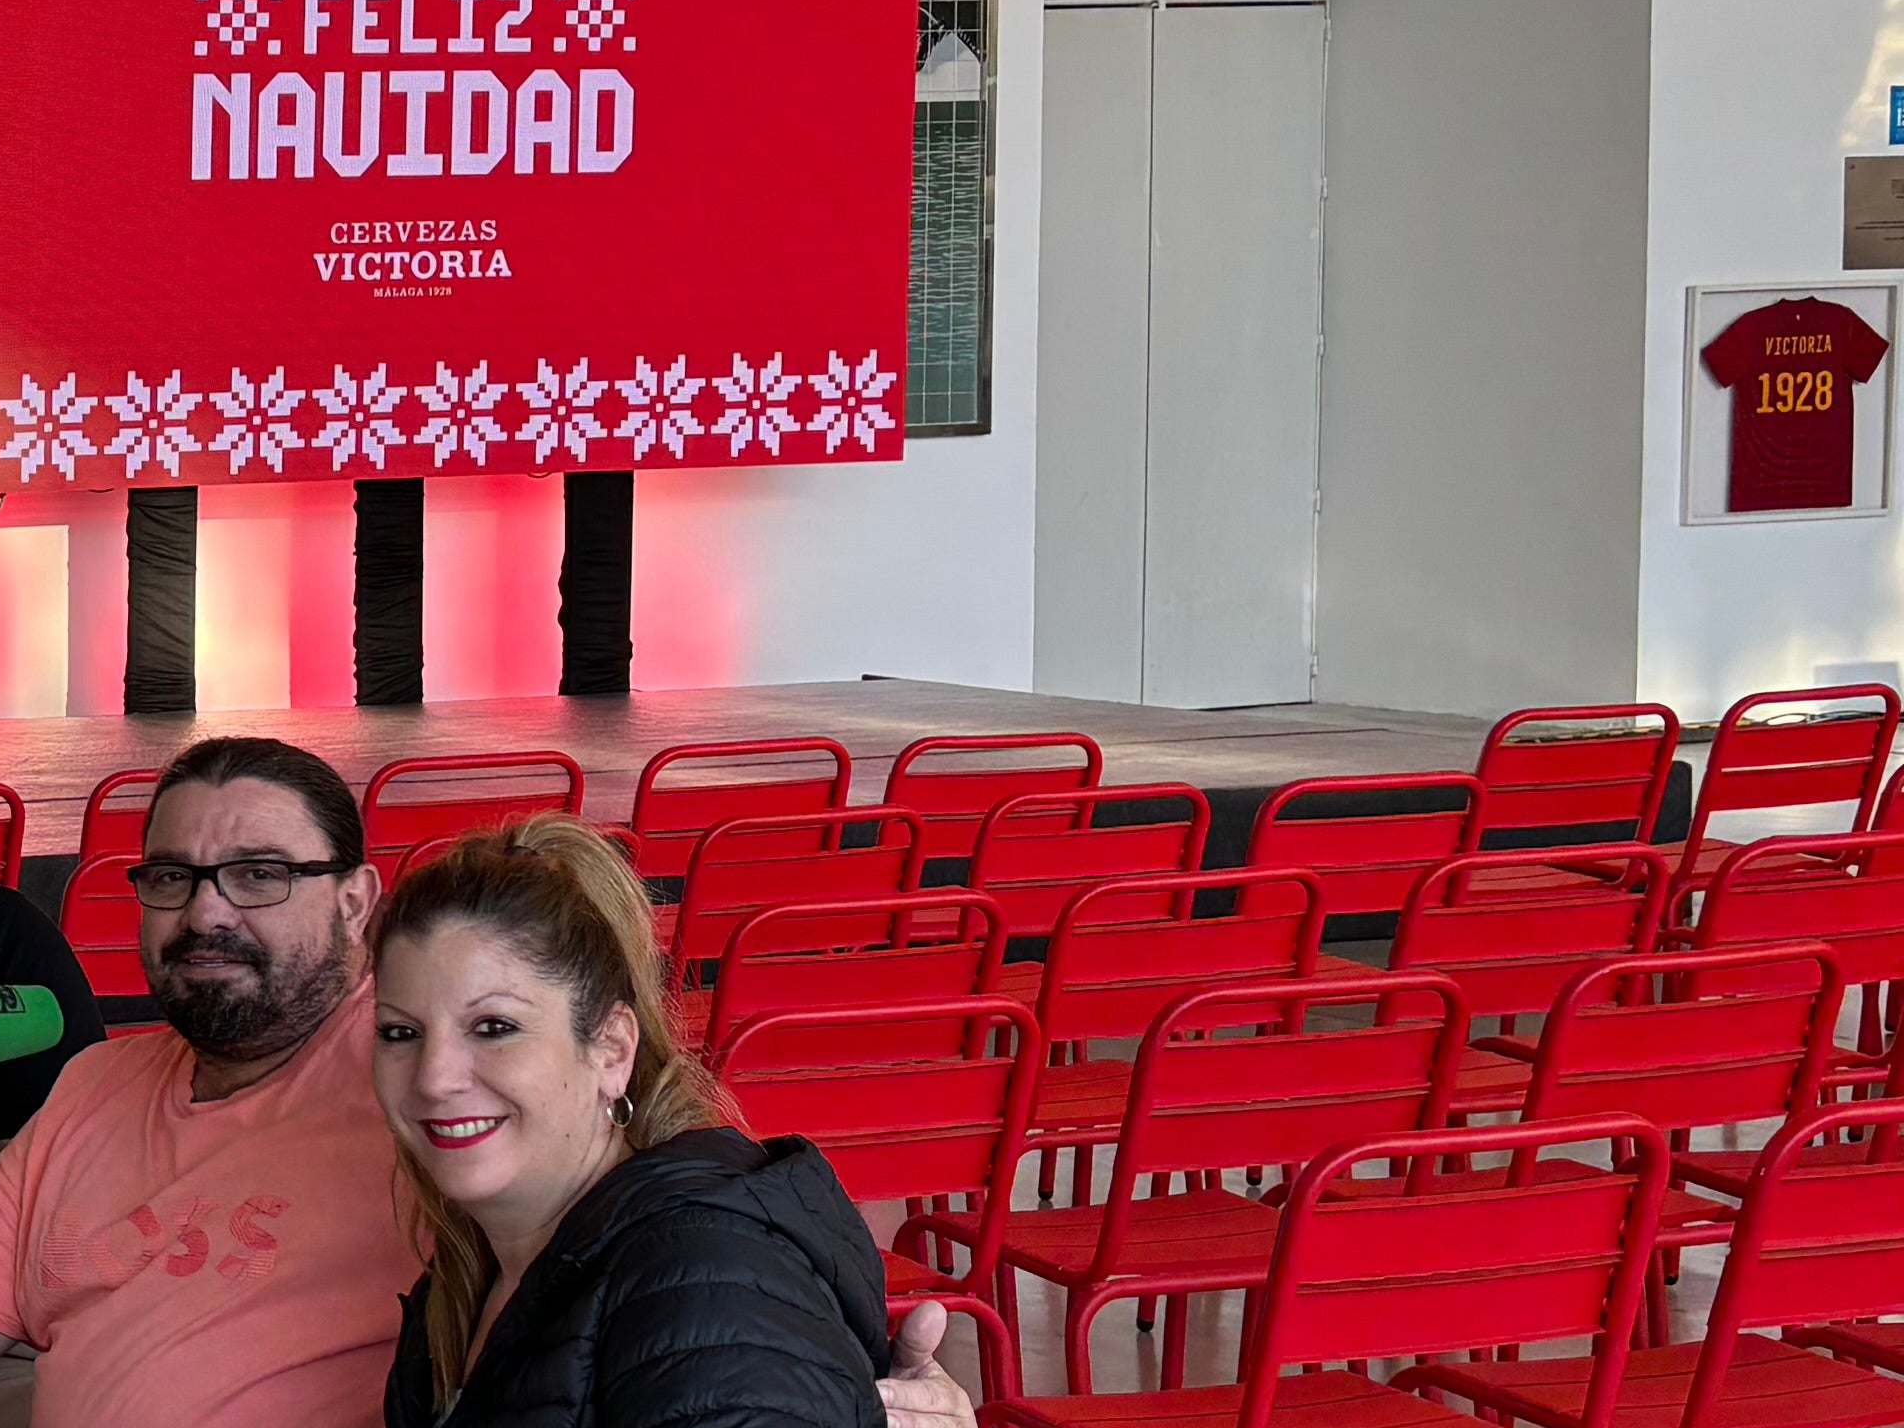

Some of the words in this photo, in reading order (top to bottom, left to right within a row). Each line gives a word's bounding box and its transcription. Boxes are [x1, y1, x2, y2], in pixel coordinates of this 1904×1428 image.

[192, 68, 636, 180] NAVIDAD
[330, 220, 497, 244] CERVEZAS
[313, 249, 512, 282] VICTORIA
[374, 286, 424, 298] MÁLAGA
[428, 286, 452, 297] 1928
[1765, 334, 1832, 356] VICTORIA
[1756, 370, 1833, 413] 1928
